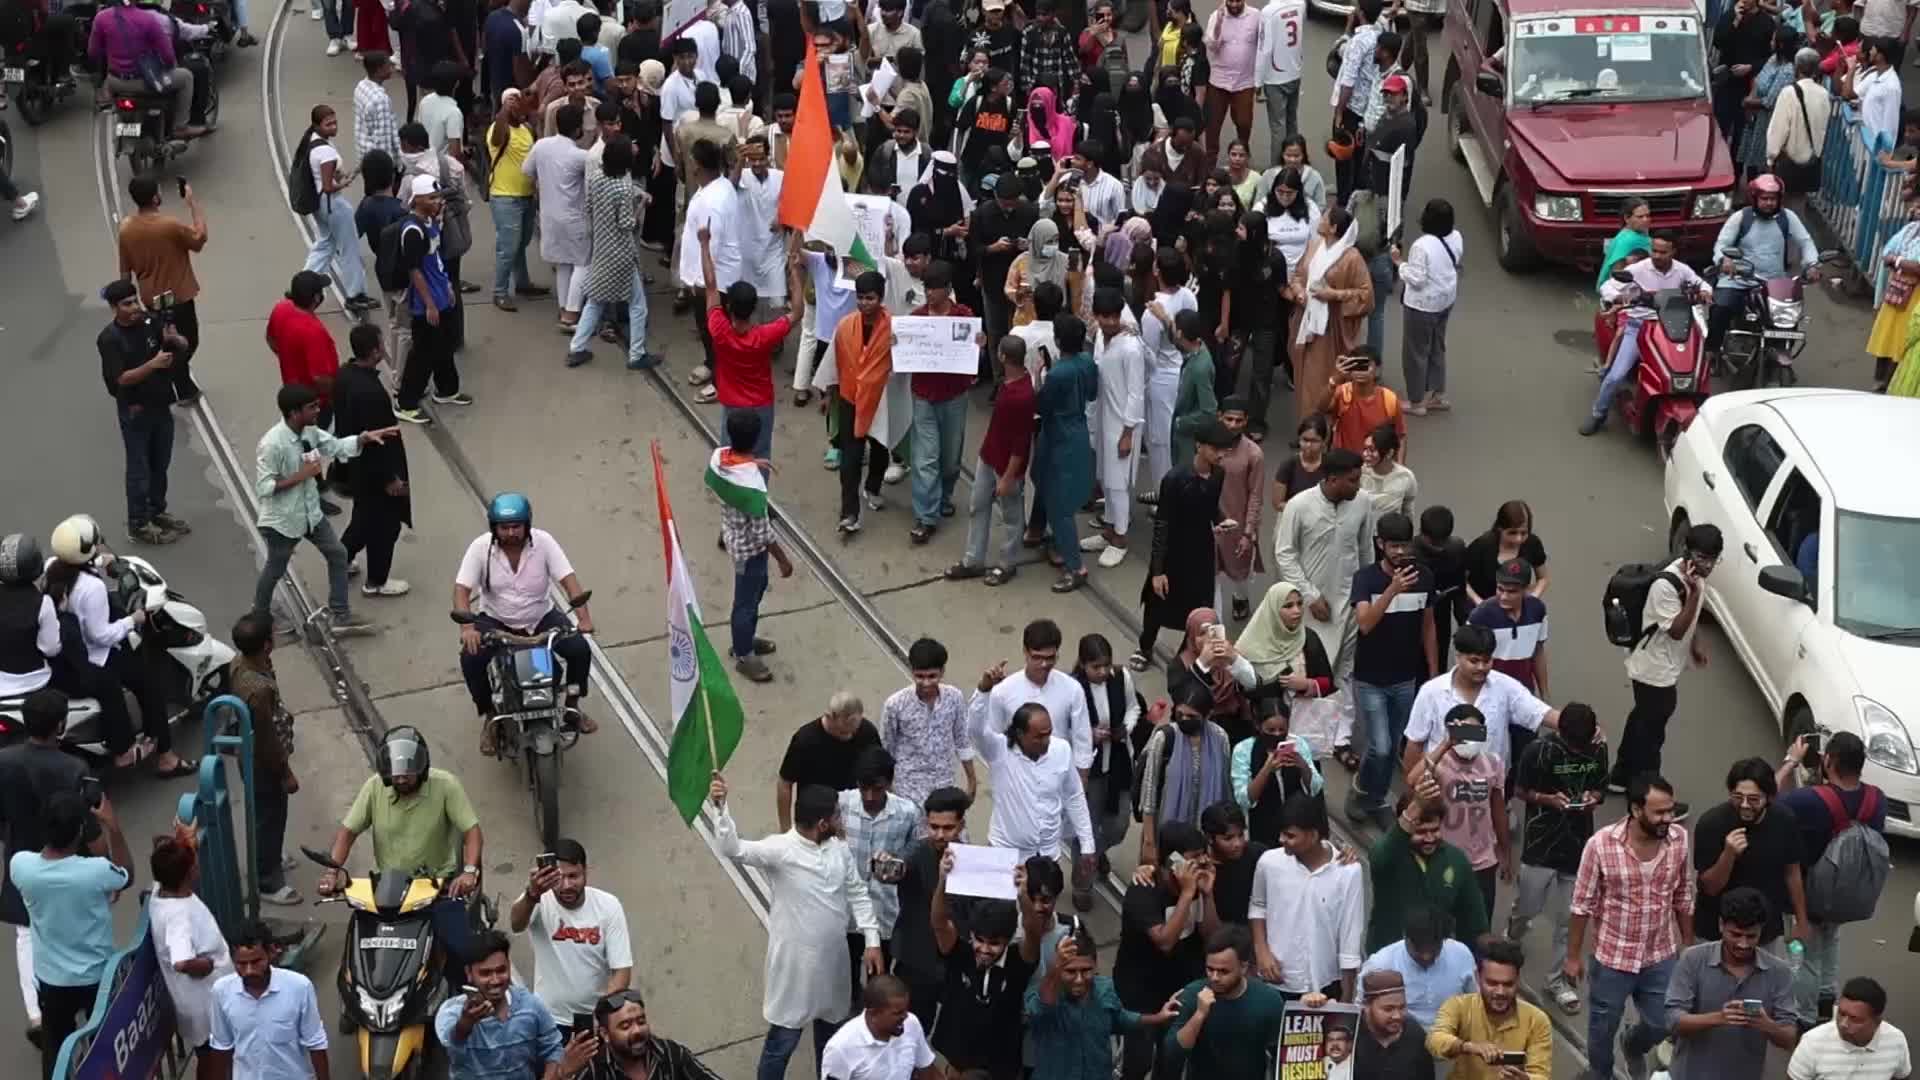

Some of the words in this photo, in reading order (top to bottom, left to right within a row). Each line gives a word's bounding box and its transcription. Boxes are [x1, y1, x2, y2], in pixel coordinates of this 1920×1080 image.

[1286, 21, 1297, 48] 3
[1285, 1015, 1324, 1033] LEAK
[1286, 1045, 1320, 1062] MUST
